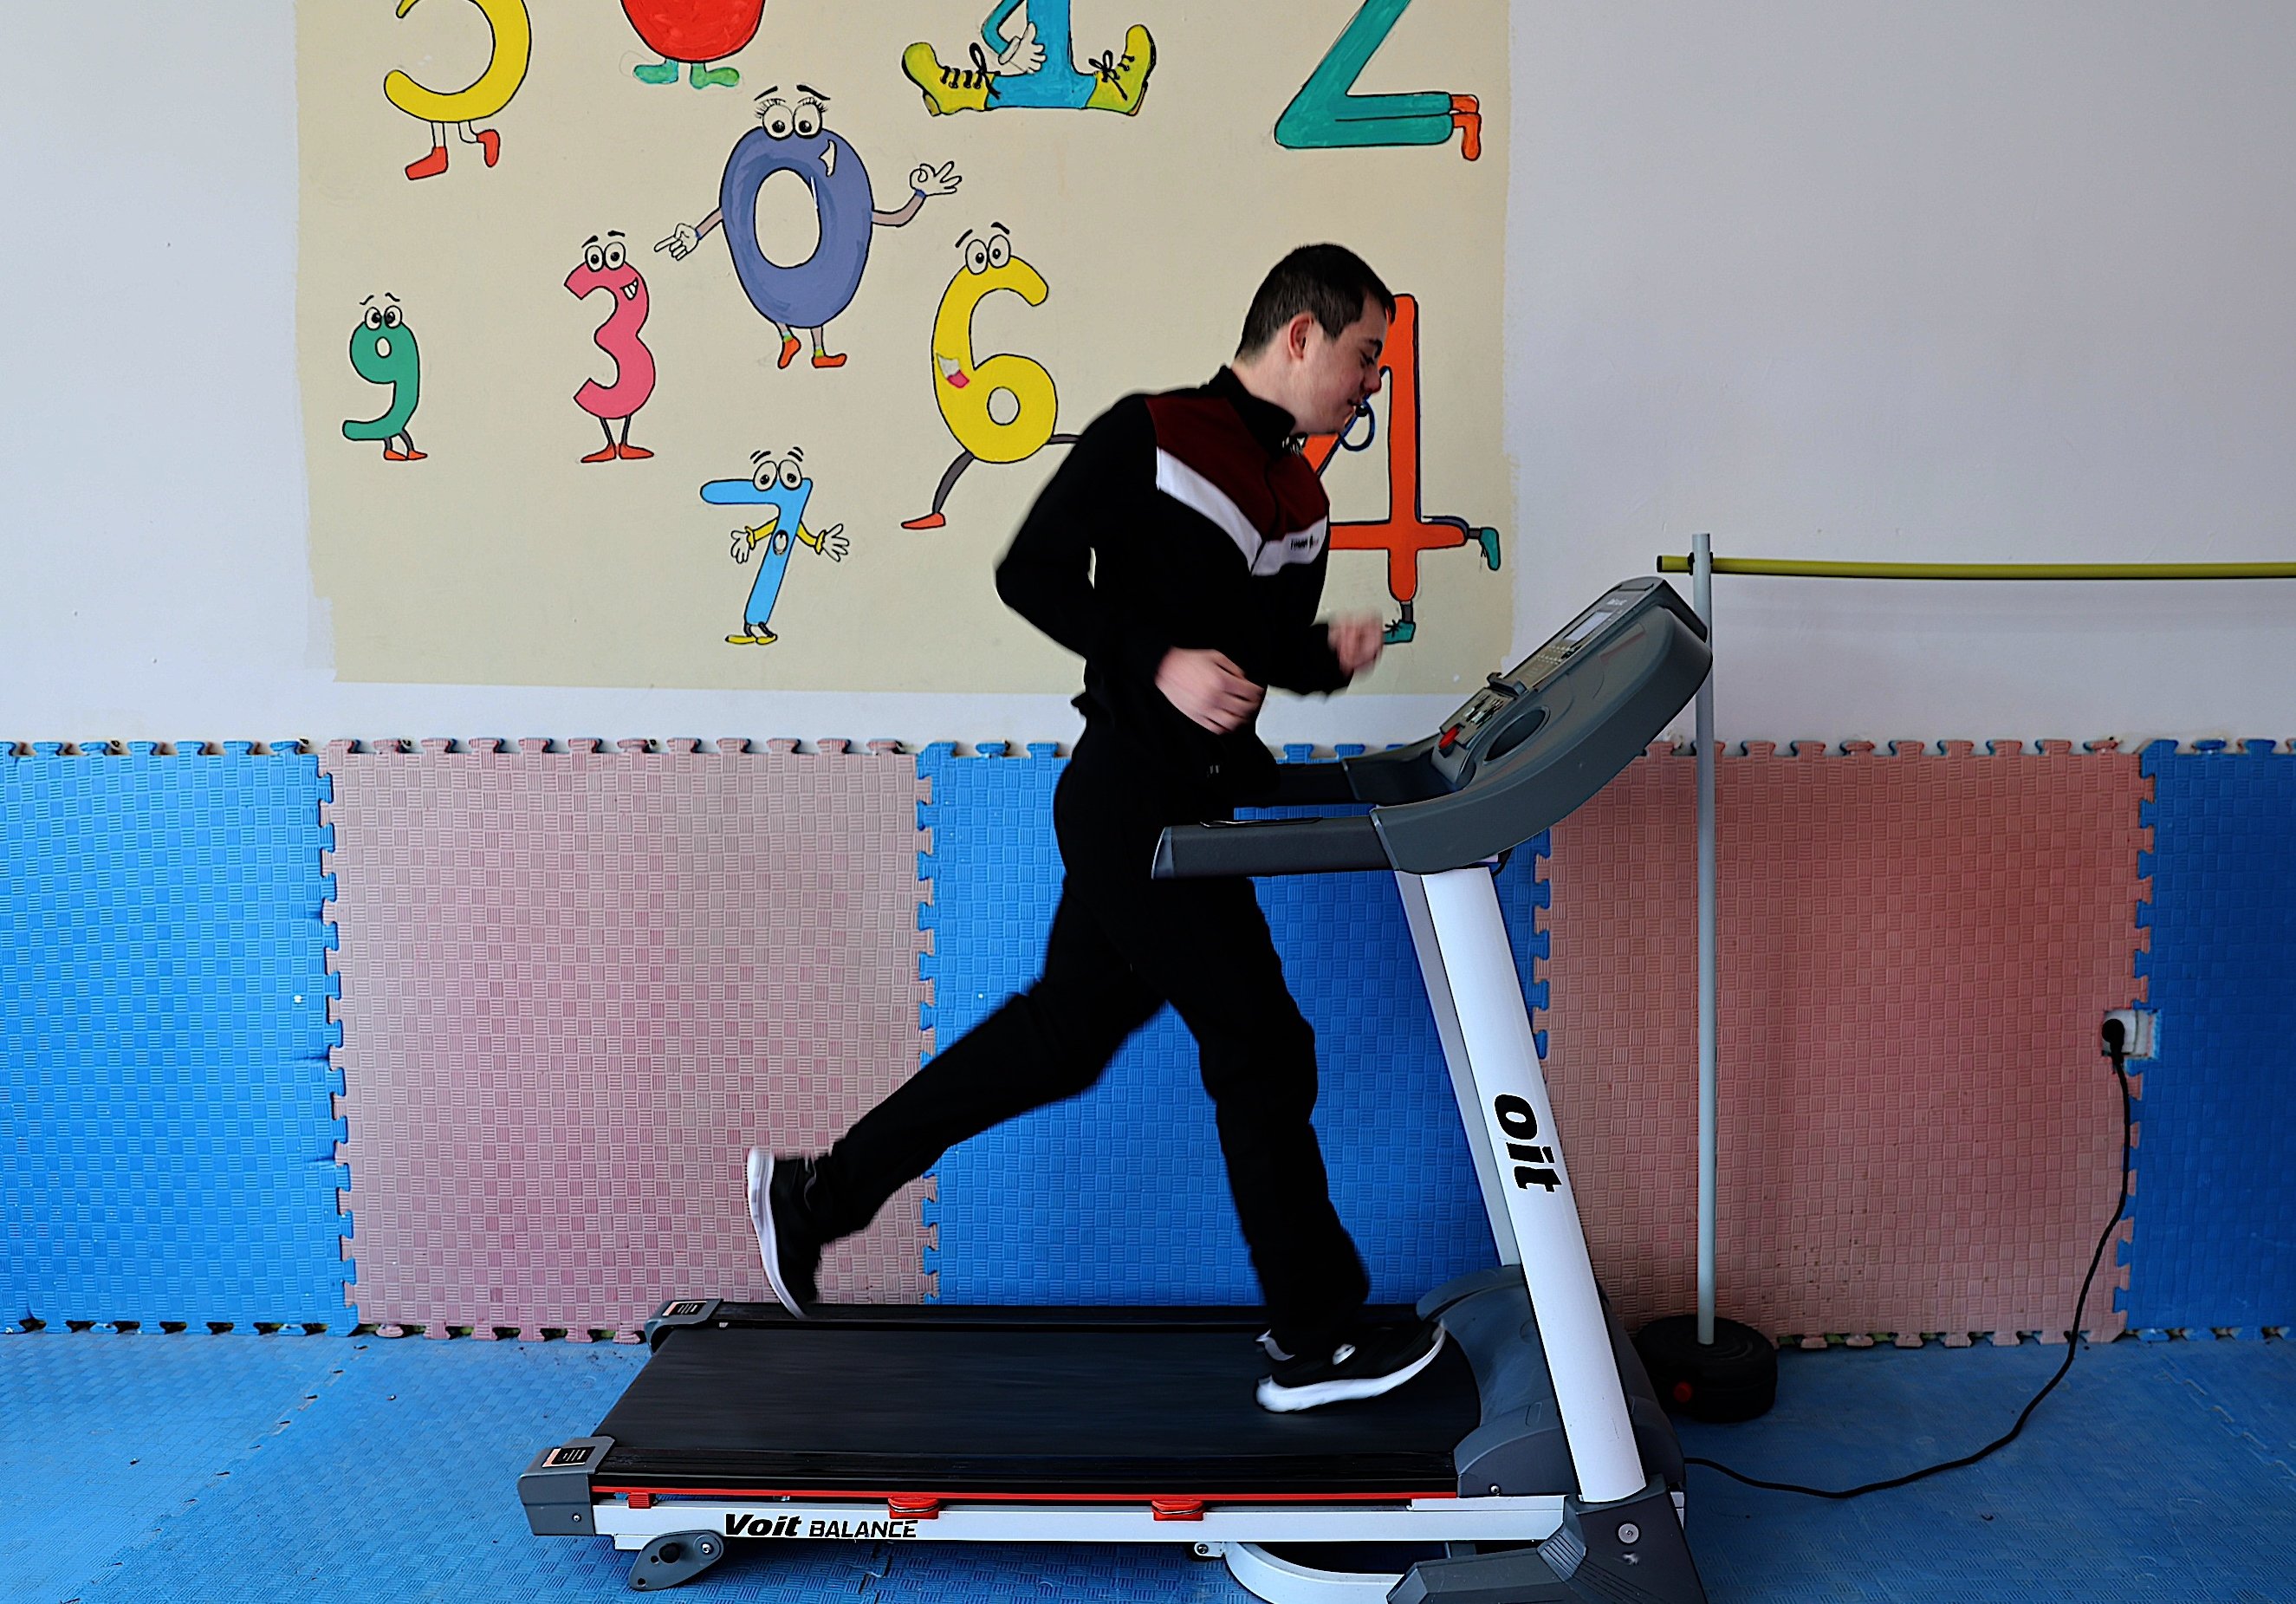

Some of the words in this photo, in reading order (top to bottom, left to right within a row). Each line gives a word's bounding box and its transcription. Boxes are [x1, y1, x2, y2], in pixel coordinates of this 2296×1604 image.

[720, 126, 873, 329] 0
[341, 315, 421, 441] 9
[563, 259, 656, 419] 3
[931, 254, 1059, 464] 6
[699, 478, 814, 627] 7
[724, 1513, 802, 1536] Voit
[808, 1519, 918, 1538] BALANCE
